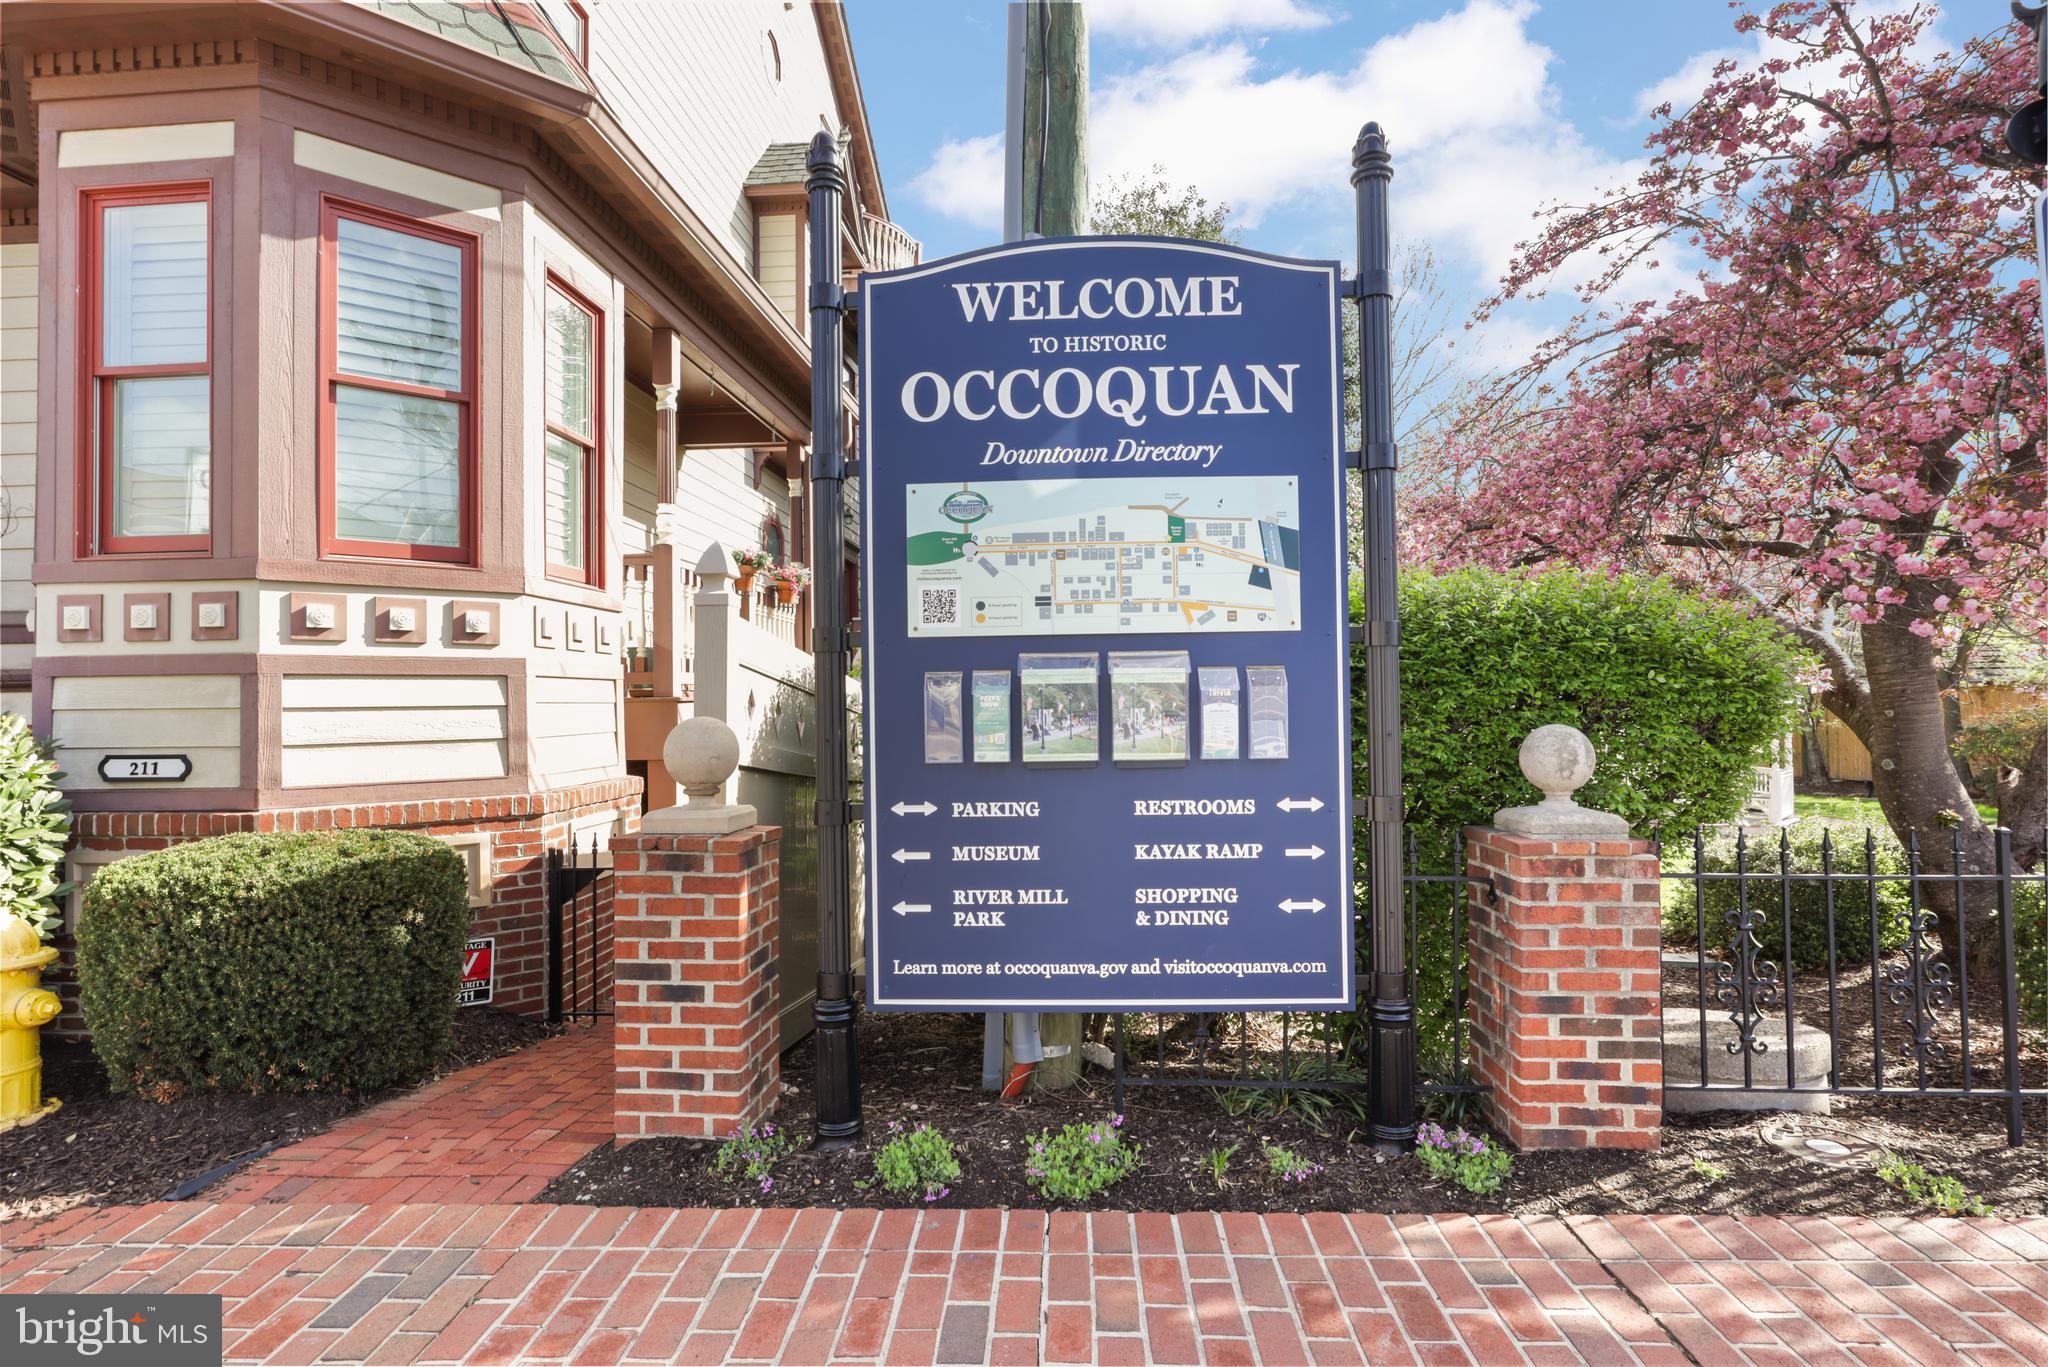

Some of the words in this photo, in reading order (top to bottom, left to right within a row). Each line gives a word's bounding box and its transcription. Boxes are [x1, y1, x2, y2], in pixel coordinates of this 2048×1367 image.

[952, 277, 1242, 322] WELCOME
[1030, 336, 1058, 353] TO
[1064, 335, 1167, 352] HISTORIC
[902, 364, 1300, 427] OCCOQUAN
[980, 442, 1108, 465] Downtown
[1111, 439, 1223, 467] Directory
[129, 761, 159, 776] 211
[951, 801, 1040, 818] PARKING
[1134, 798, 1255, 816] RESTROOMS
[951, 845, 1040, 861] MUSEUM
[1134, 843, 1202, 860] KAYAK
[1204, 842, 1263, 860] RAMP
[952, 889, 1015, 905] RIVER
[1017, 888, 1069, 905] MILL
[1135, 887, 1239, 905] SHOPPING
[952, 911, 1007, 927] PARK
[1135, 911, 1152, 927] &
[1154, 909, 1230, 927] DINING
[464, 941, 487, 950] TAGE
[892, 959, 939, 975] Learn
[941, 963, 983, 975] more
[985, 961, 1001, 975] at
[1003, 963, 1129, 979] occoquanva.gov
[1131, 957, 1161, 975] and
[1163, 958, 1328, 978] visitoccoquanva.com
[460, 979, 487, 990] URITY
[455, 990, 475, 1003] 211
